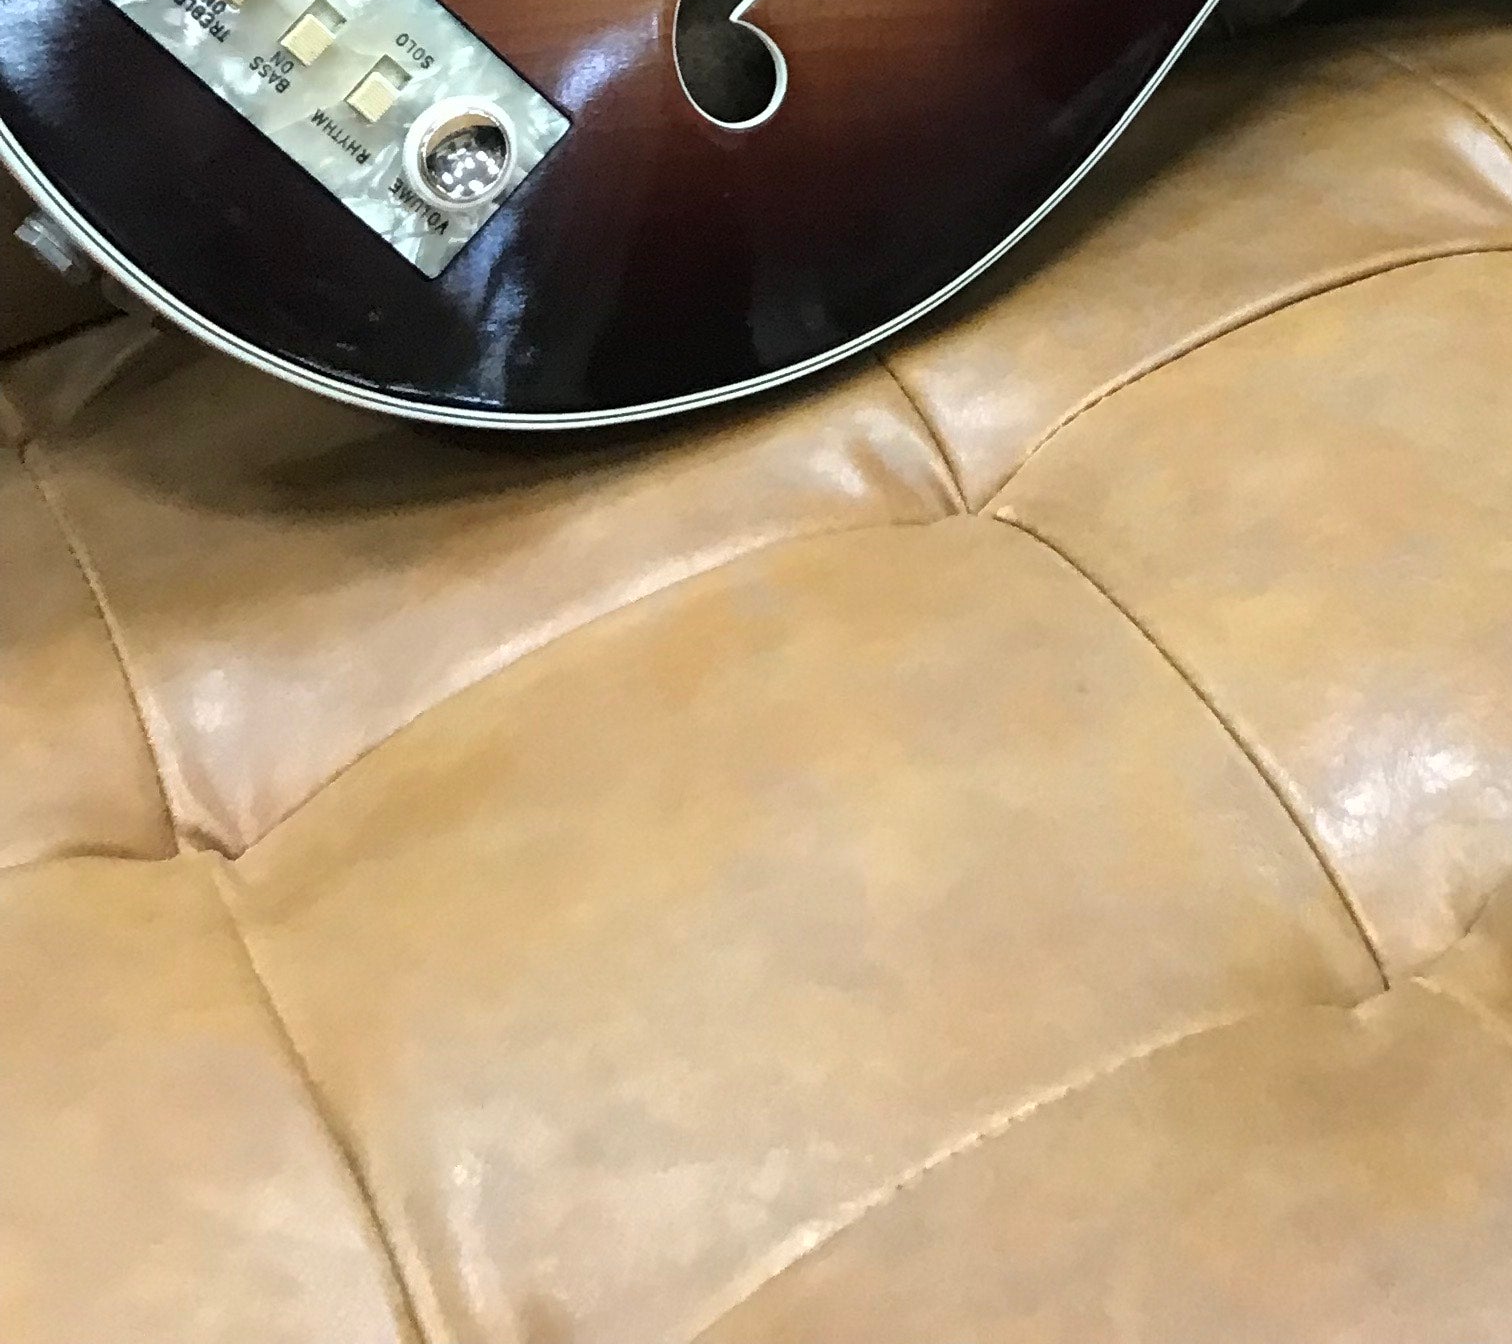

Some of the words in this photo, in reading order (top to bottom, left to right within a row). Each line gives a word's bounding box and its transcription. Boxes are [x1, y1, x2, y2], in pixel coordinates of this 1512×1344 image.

[270, 50, 295, 75] ON
[395, 33, 435, 70] SOLO
[249, 56, 291, 94] BASS
[311, 108, 371, 165] RHYTHM
[388, 177, 450, 236] VOLUME
